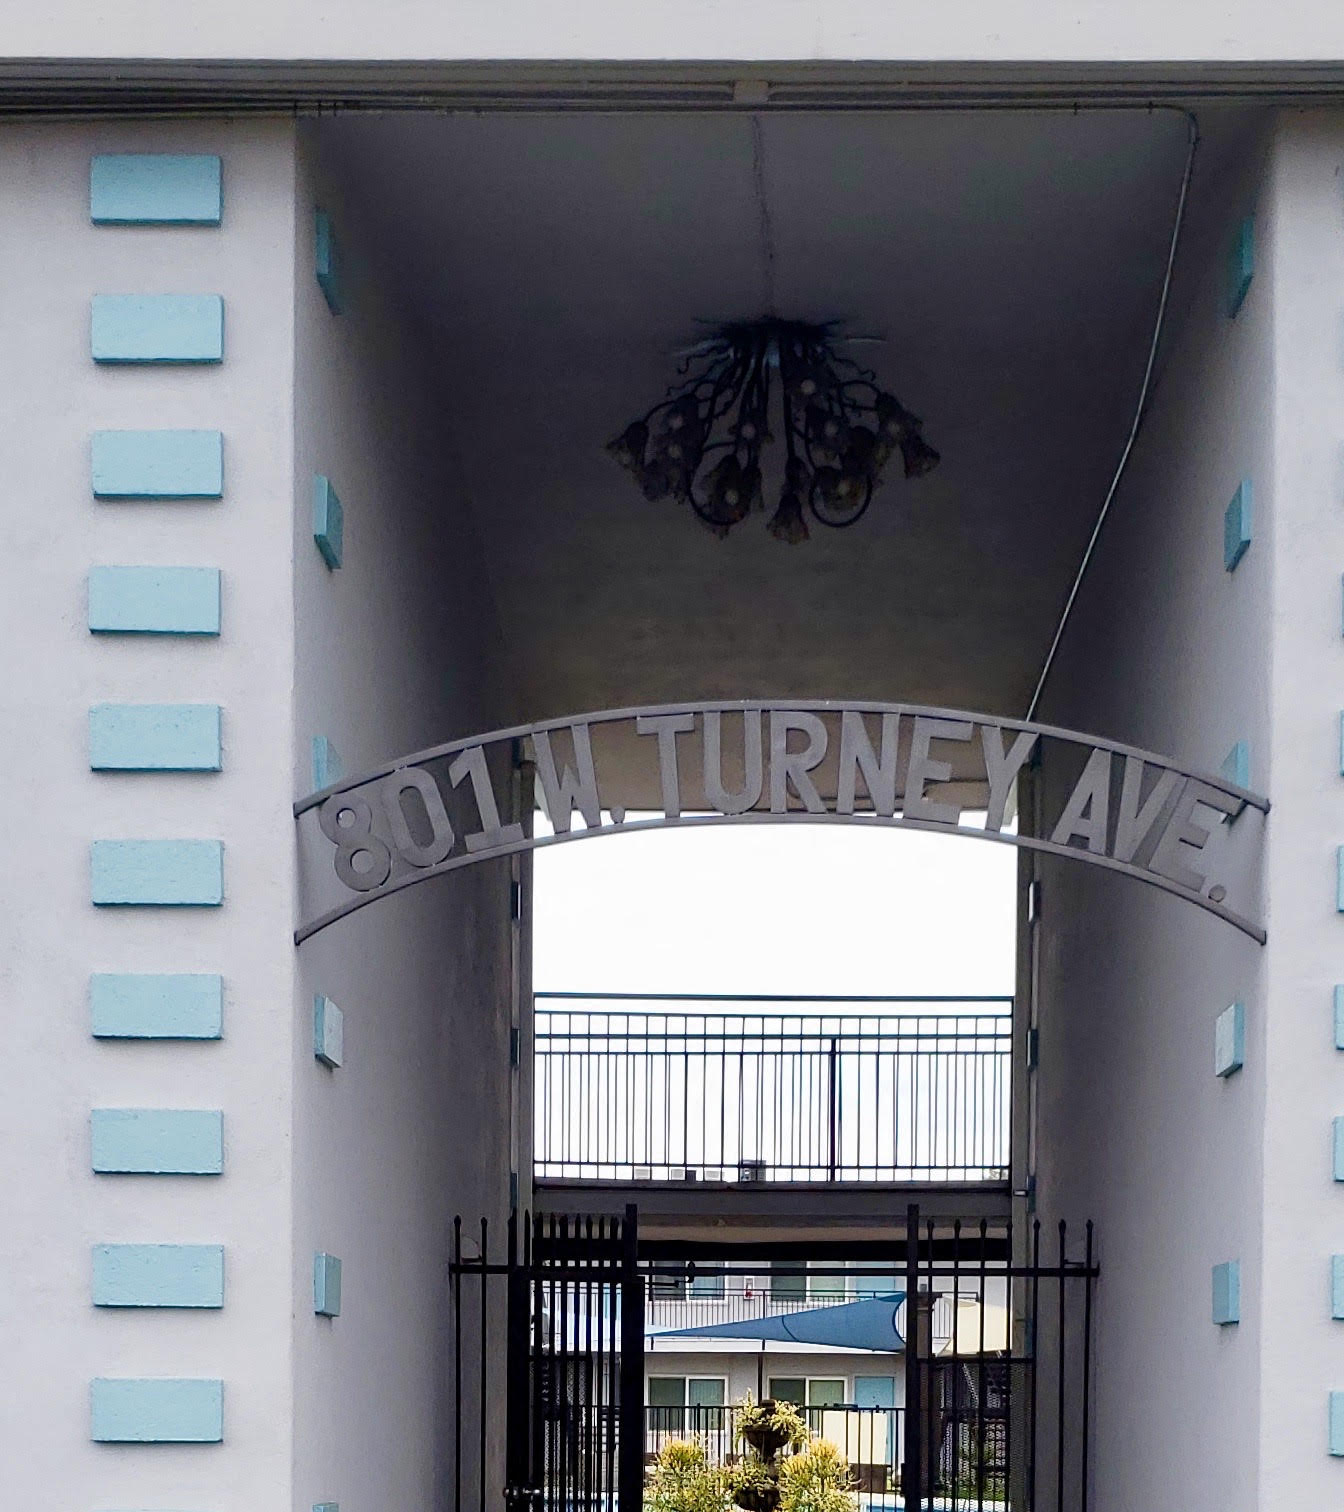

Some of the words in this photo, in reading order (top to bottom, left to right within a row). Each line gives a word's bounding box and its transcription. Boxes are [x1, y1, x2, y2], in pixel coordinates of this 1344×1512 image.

[319, 745, 521, 892] 801
[532, 724, 626, 834] W.
[637, 709, 1038, 832] TURNEY
[1051, 747, 1245, 902] AVE.
